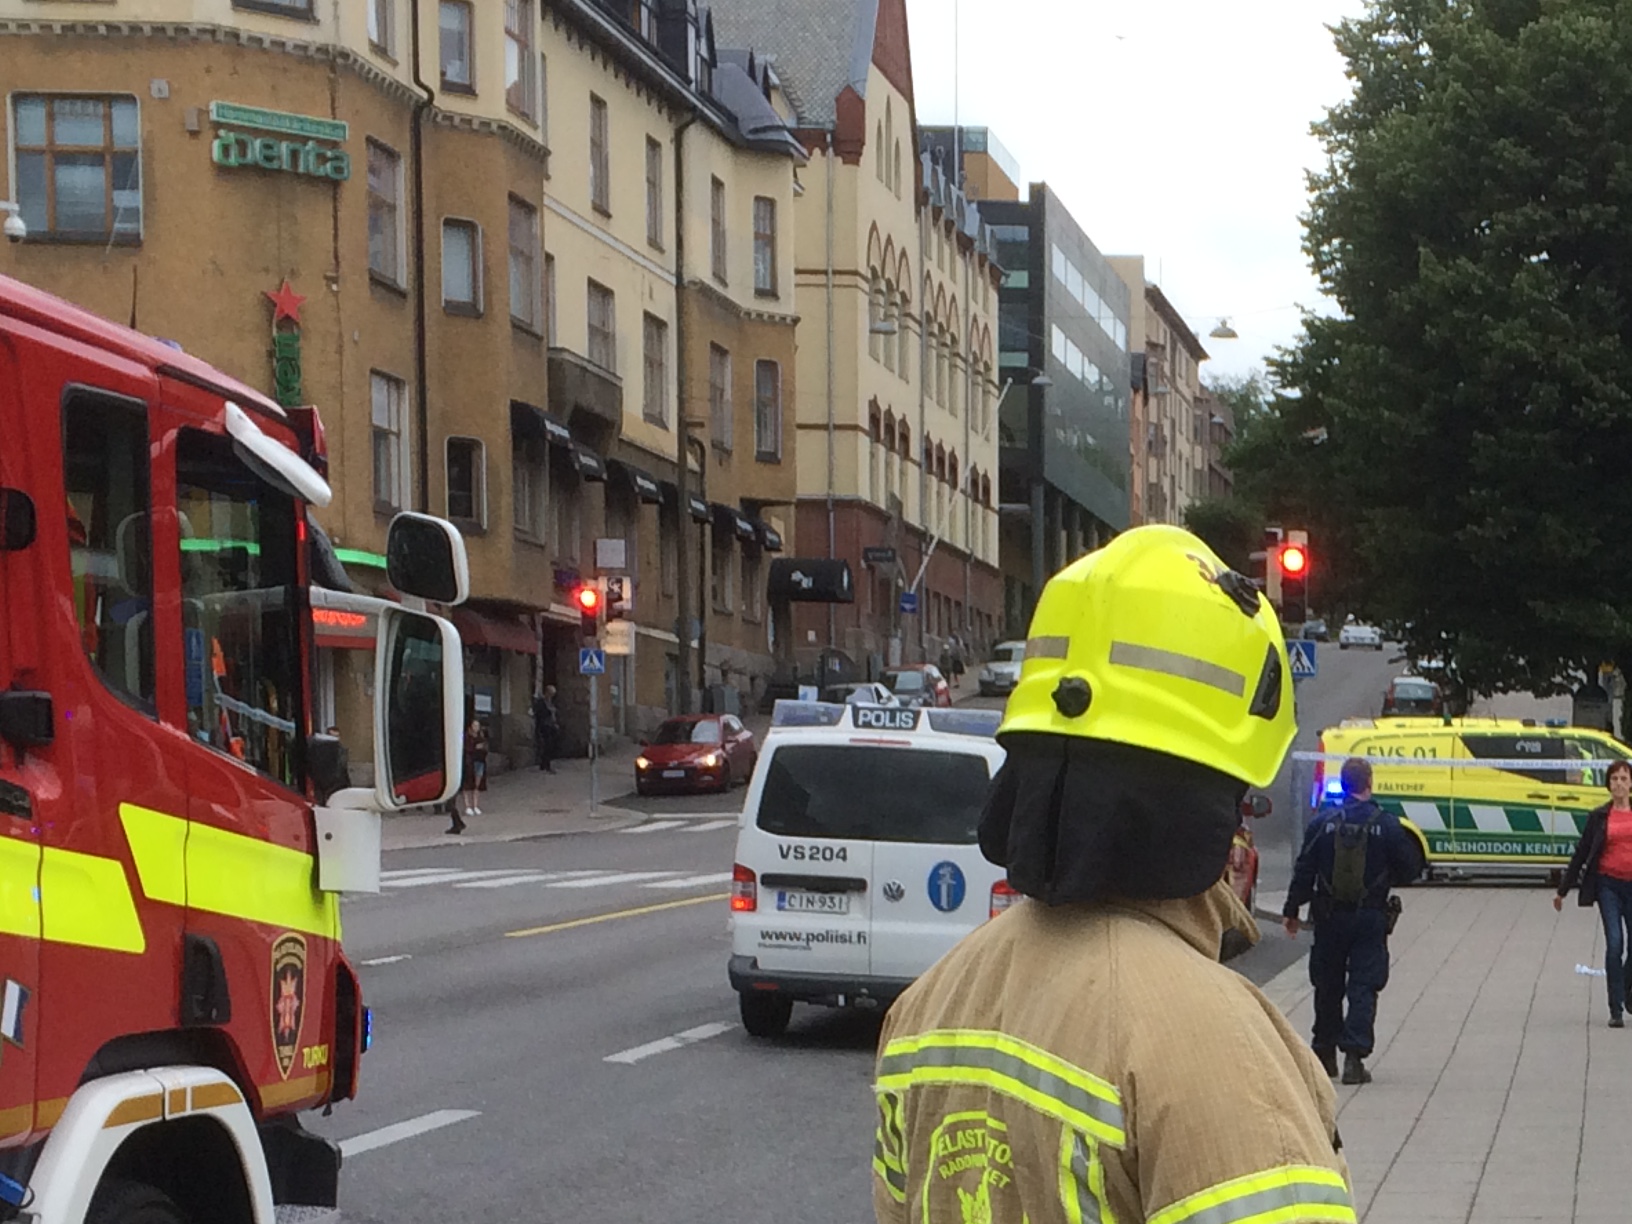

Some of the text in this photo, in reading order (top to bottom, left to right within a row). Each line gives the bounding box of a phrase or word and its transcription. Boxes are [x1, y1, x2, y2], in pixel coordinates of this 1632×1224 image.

[858, 709, 914, 729] POLIS
[778, 844, 848, 862] VS204
[1435, 842, 1521, 854] ENSIHOIDON
[760, 929, 868, 946] www.poliisi.fi
